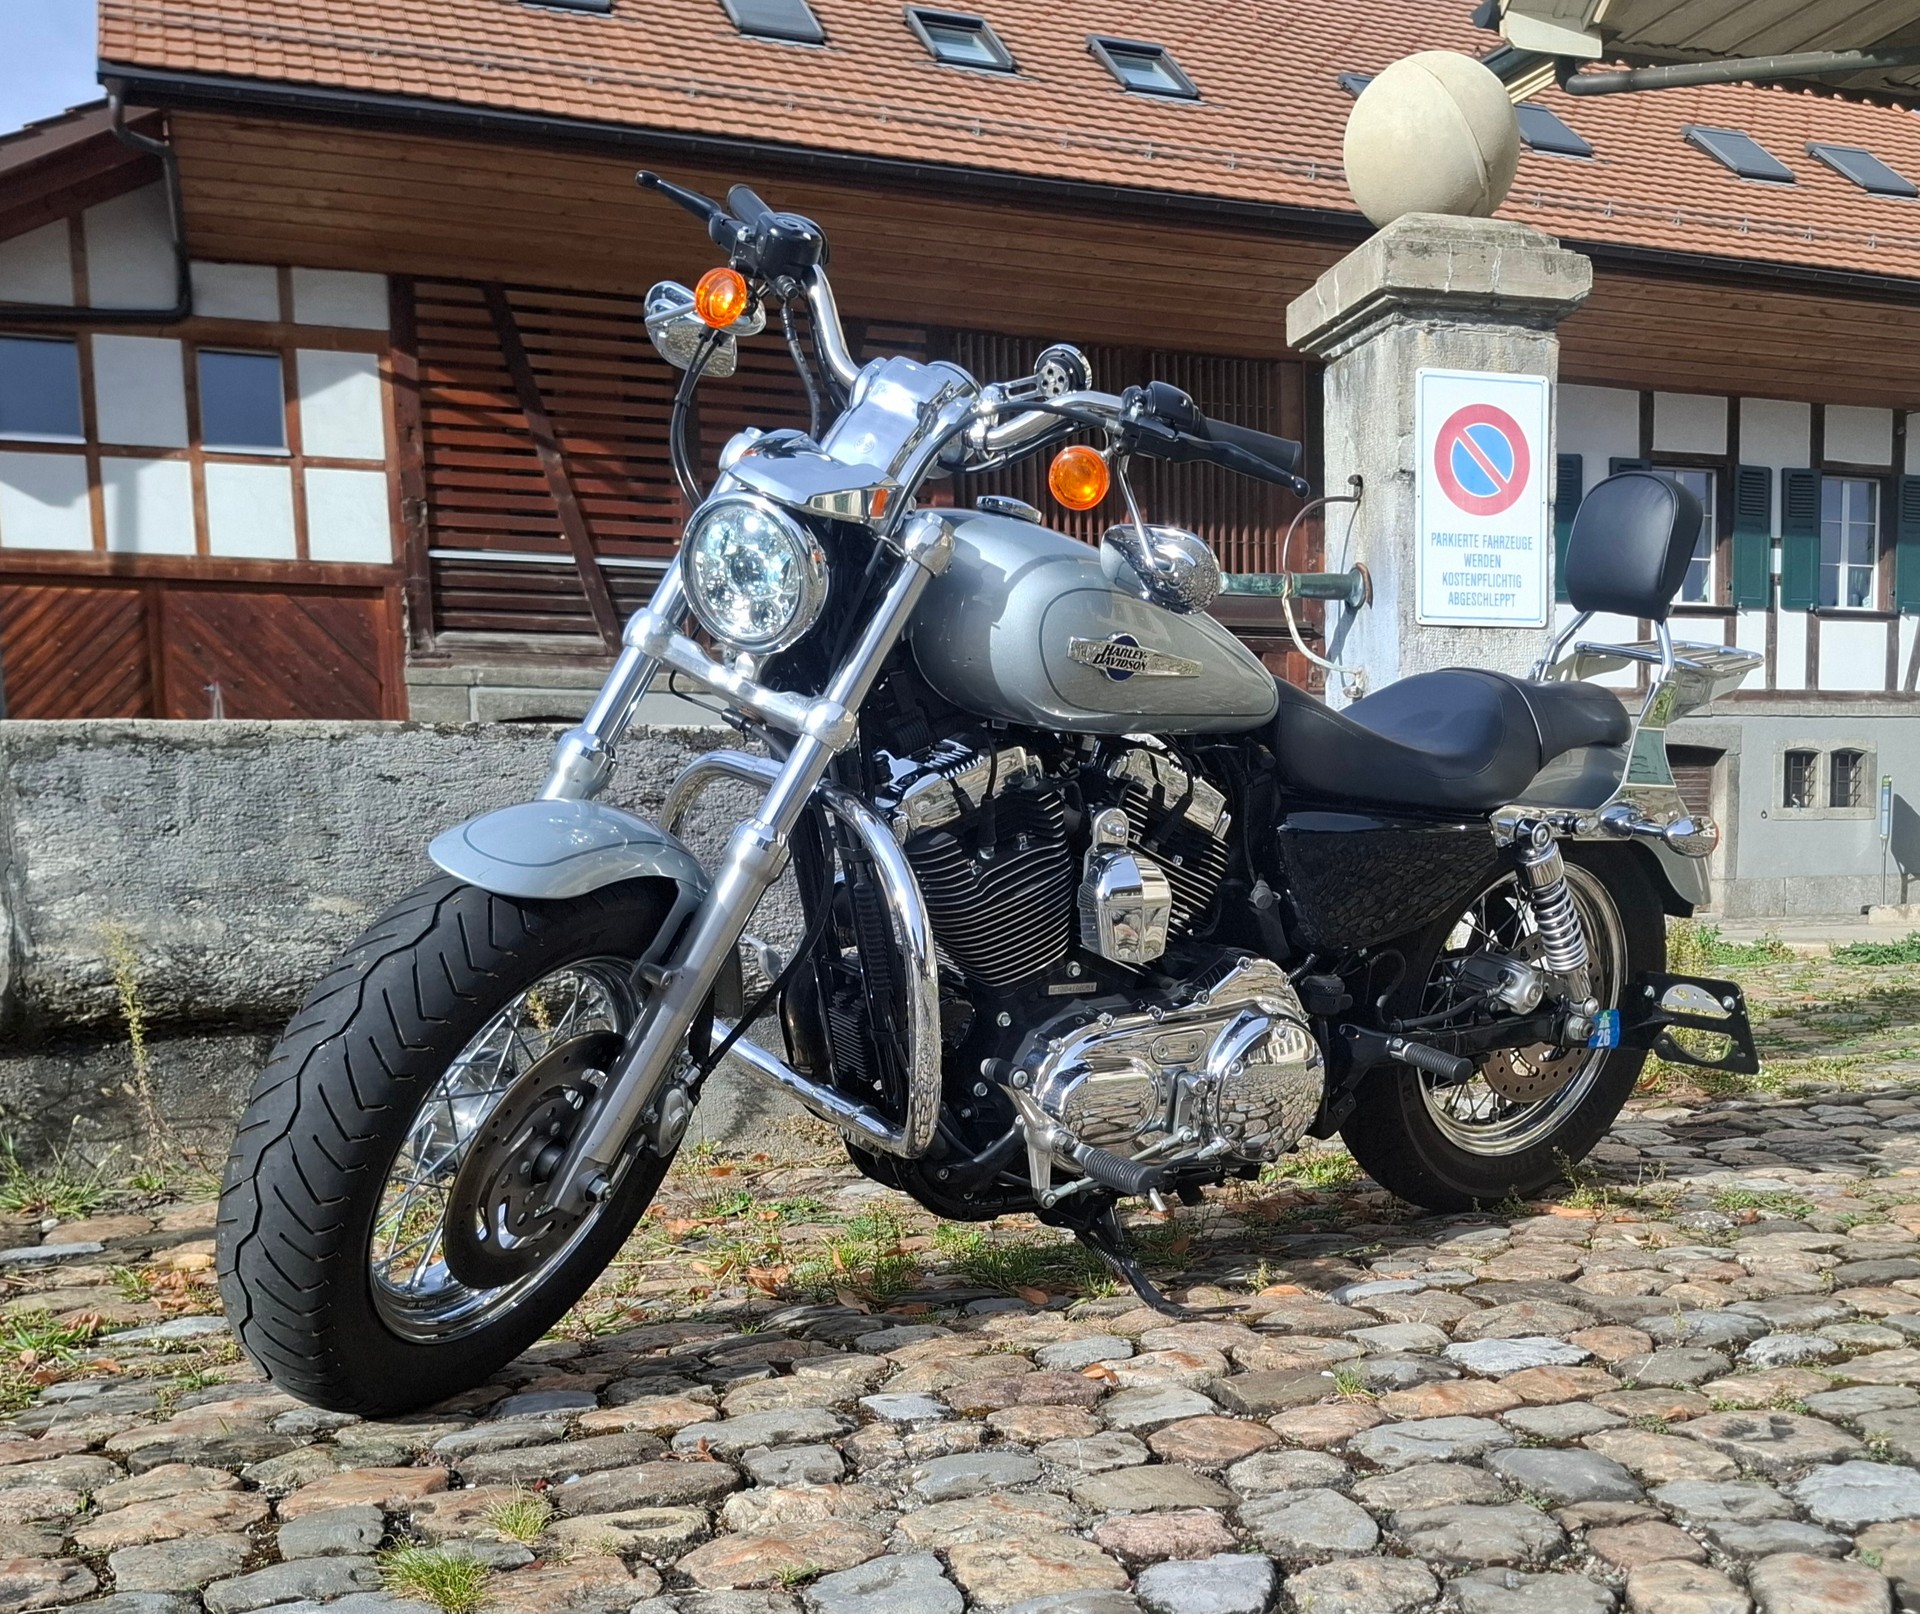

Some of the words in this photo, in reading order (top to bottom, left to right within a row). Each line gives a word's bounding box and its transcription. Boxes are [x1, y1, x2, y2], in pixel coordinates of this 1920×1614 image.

[1431, 532, 1479, 548] PARKIERTE
[1482, 534, 1533, 550] FAHRZEUGE
[1464, 553, 1501, 568] WERDEN
[1442, 572, 1522, 588] KOSTENPFLICHTIG
[1448, 591, 1516, 607] ABGESCHLEPPT
[1103, 644, 1148, 660] HARLEY-
[1092, 653, 1147, 670] DAVIDSON
[1596, 1029, 1610, 1047] 26
